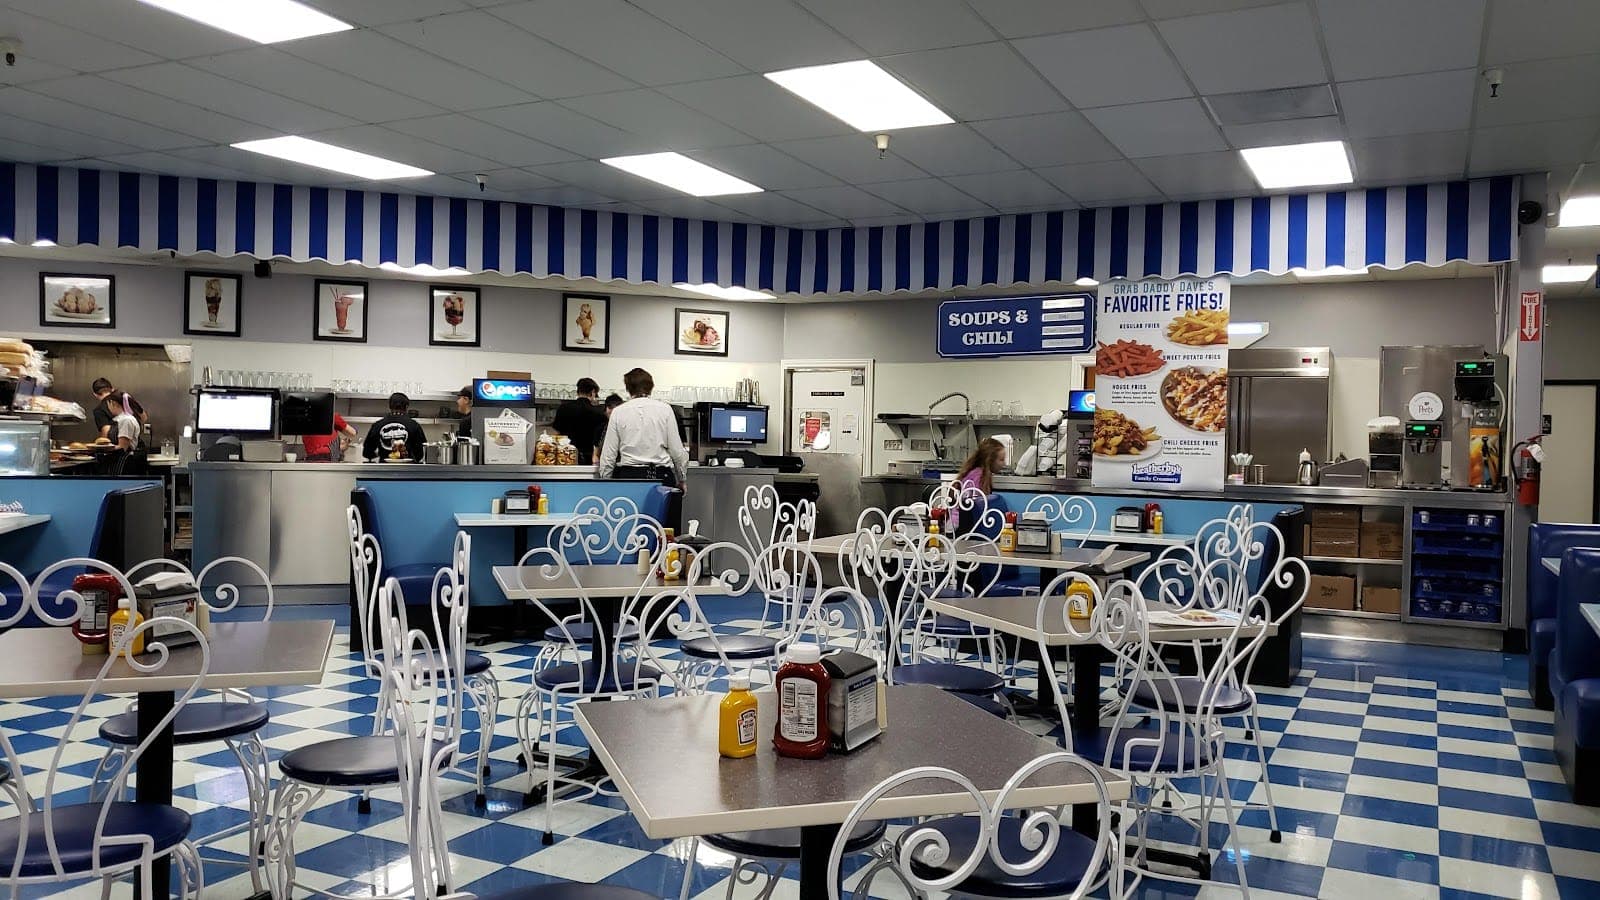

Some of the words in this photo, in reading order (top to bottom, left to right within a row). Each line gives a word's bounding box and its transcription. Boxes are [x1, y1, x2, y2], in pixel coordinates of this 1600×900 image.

[1113, 284, 1140, 295] GRAB
[1143, 282, 1175, 293] DADDY
[1180, 280, 1214, 292] DAVE'S
[1104, 294, 1171, 313] FAVORITE
[1176, 293, 1223, 311] FRIES!
[948, 310, 1011, 326] SOUPS
[1015, 310, 1029, 324] &
[962, 330, 1014, 345] CHILI
[497, 383, 532, 396] pepsi
